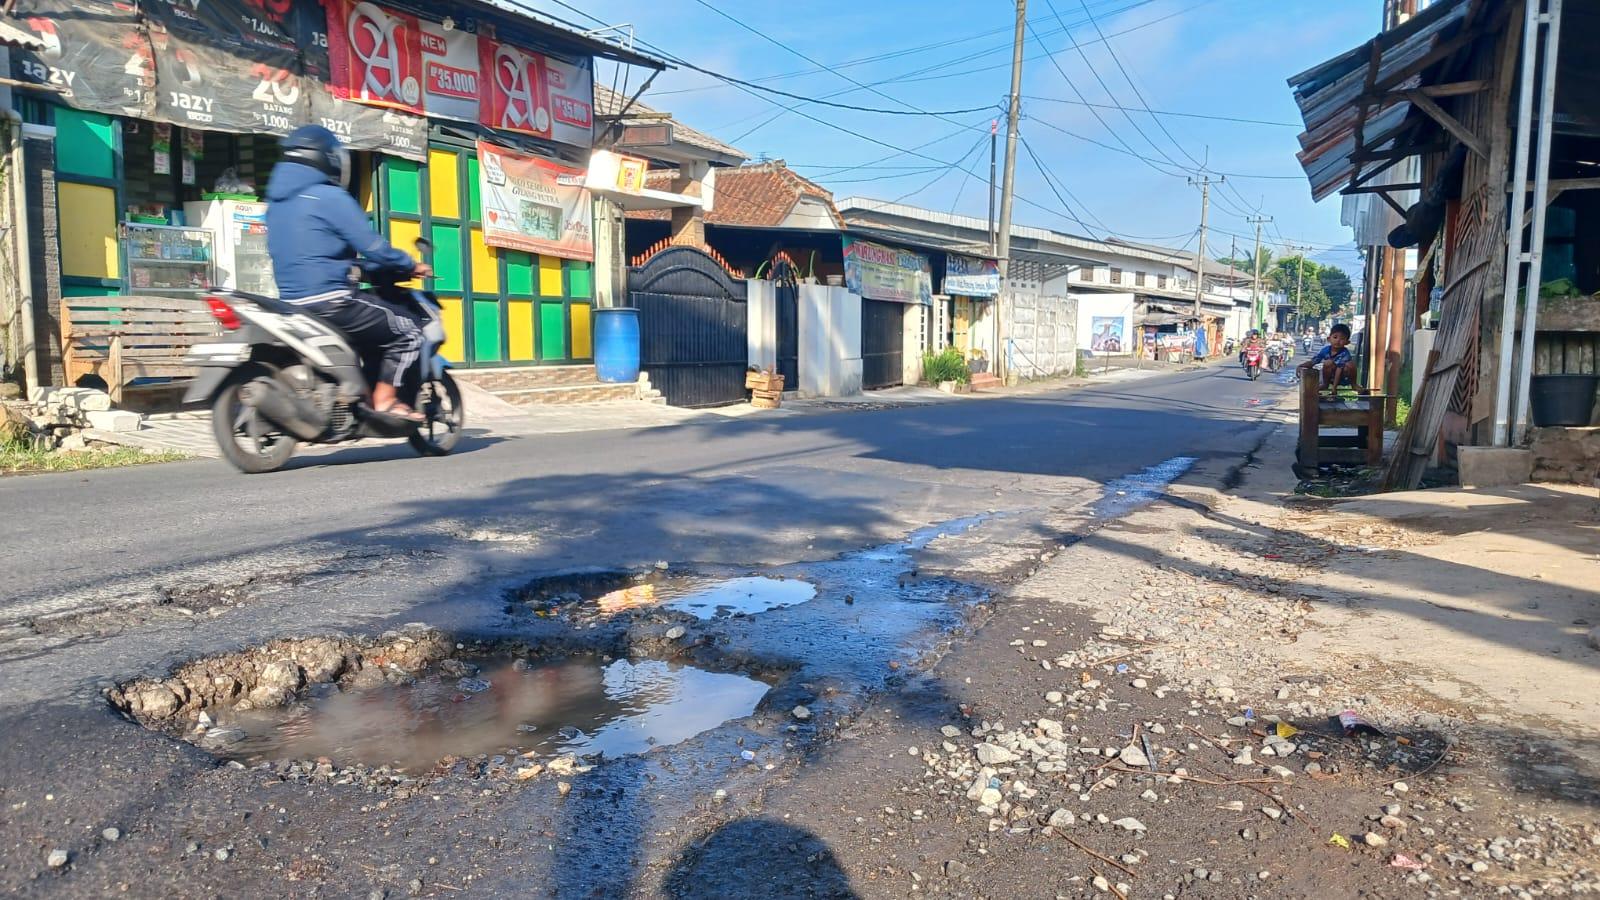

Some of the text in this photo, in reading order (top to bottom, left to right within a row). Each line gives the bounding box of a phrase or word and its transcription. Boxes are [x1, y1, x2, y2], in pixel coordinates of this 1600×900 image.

[421, 34, 446, 52] NEW
[251, 63, 299, 106] 20
[263, 103, 293, 116] BATANG
